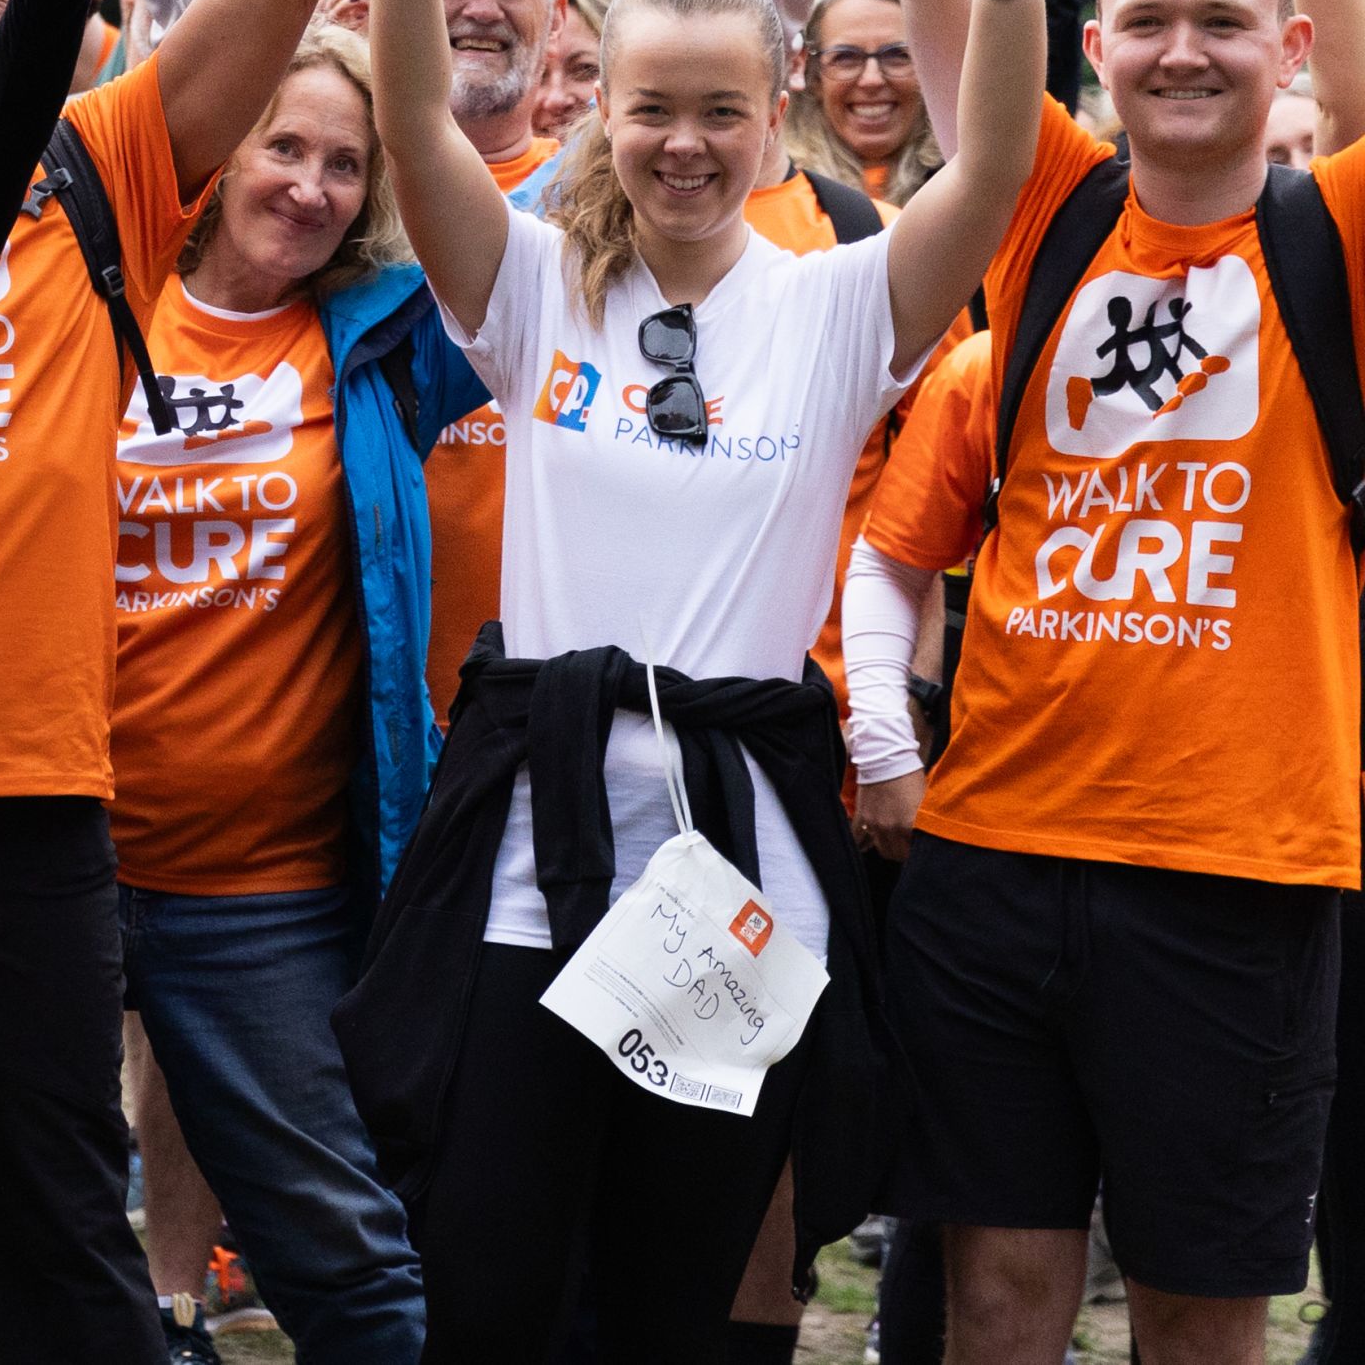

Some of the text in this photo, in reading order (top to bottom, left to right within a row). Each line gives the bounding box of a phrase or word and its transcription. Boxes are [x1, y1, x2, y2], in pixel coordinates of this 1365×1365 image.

[621, 383, 725, 426] CE
[232, 471, 299, 512] TO
[1041, 460, 1252, 521] WALK TO
[1034, 519, 1244, 609] CURE
[116, 586, 283, 613] ARKINSON'S
[1005, 606, 1232, 651] PARKINSON'S
[650, 903, 687, 954] My
[663, 958, 720, 1020] DAD
[617, 1028, 669, 1088] 053
